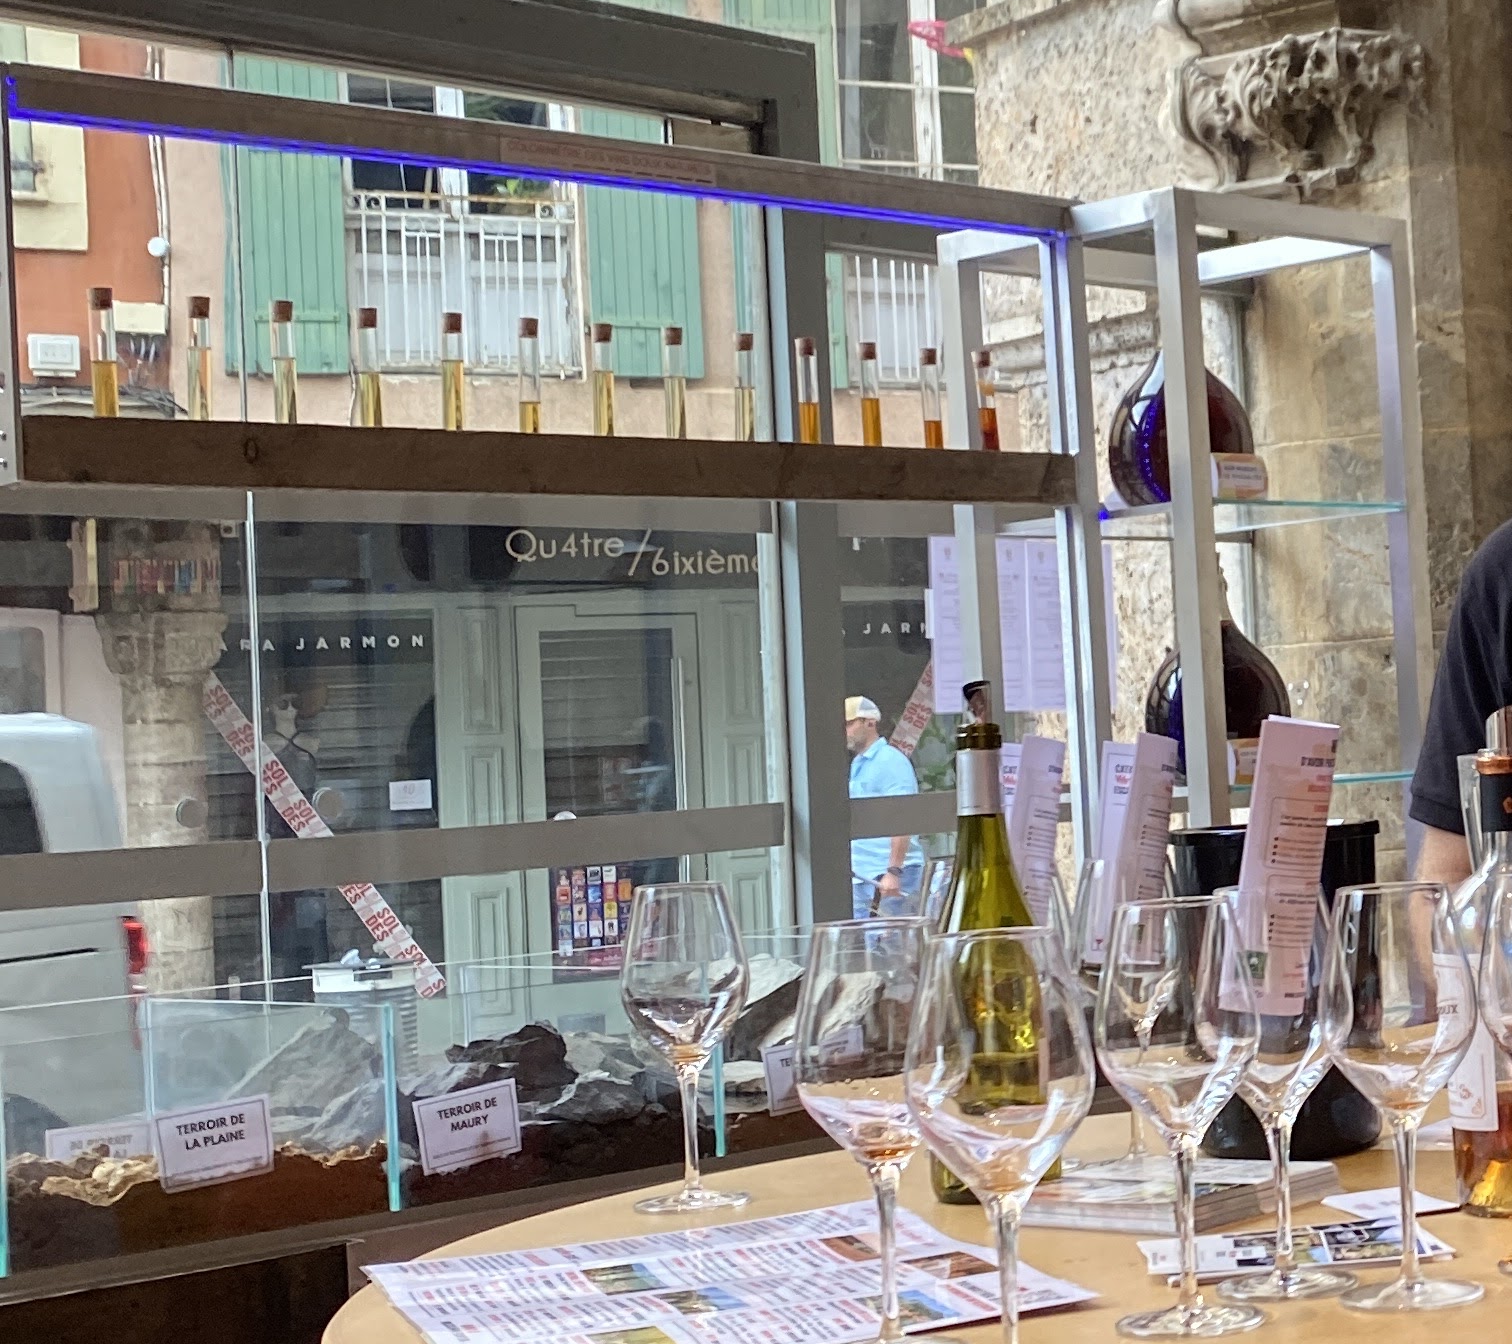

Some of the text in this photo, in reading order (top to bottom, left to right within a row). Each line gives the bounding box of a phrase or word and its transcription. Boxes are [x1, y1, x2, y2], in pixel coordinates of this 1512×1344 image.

[296, 634, 424, 651] JARMON
[262, 769, 278, 795] ES
[266, 760, 289, 788] SOL
[282, 807, 305, 832] DES
[293, 798, 317, 825] SOL
[365, 915, 389, 942] DES
[377, 907, 400, 934] SOL
[436, 1097, 498, 1120] TERROIR DE
[176, 1113, 246, 1136] TERROIR DE
[451, 1114, 489, 1132] MAURY
[185, 1129, 246, 1151] LA PLAINE
